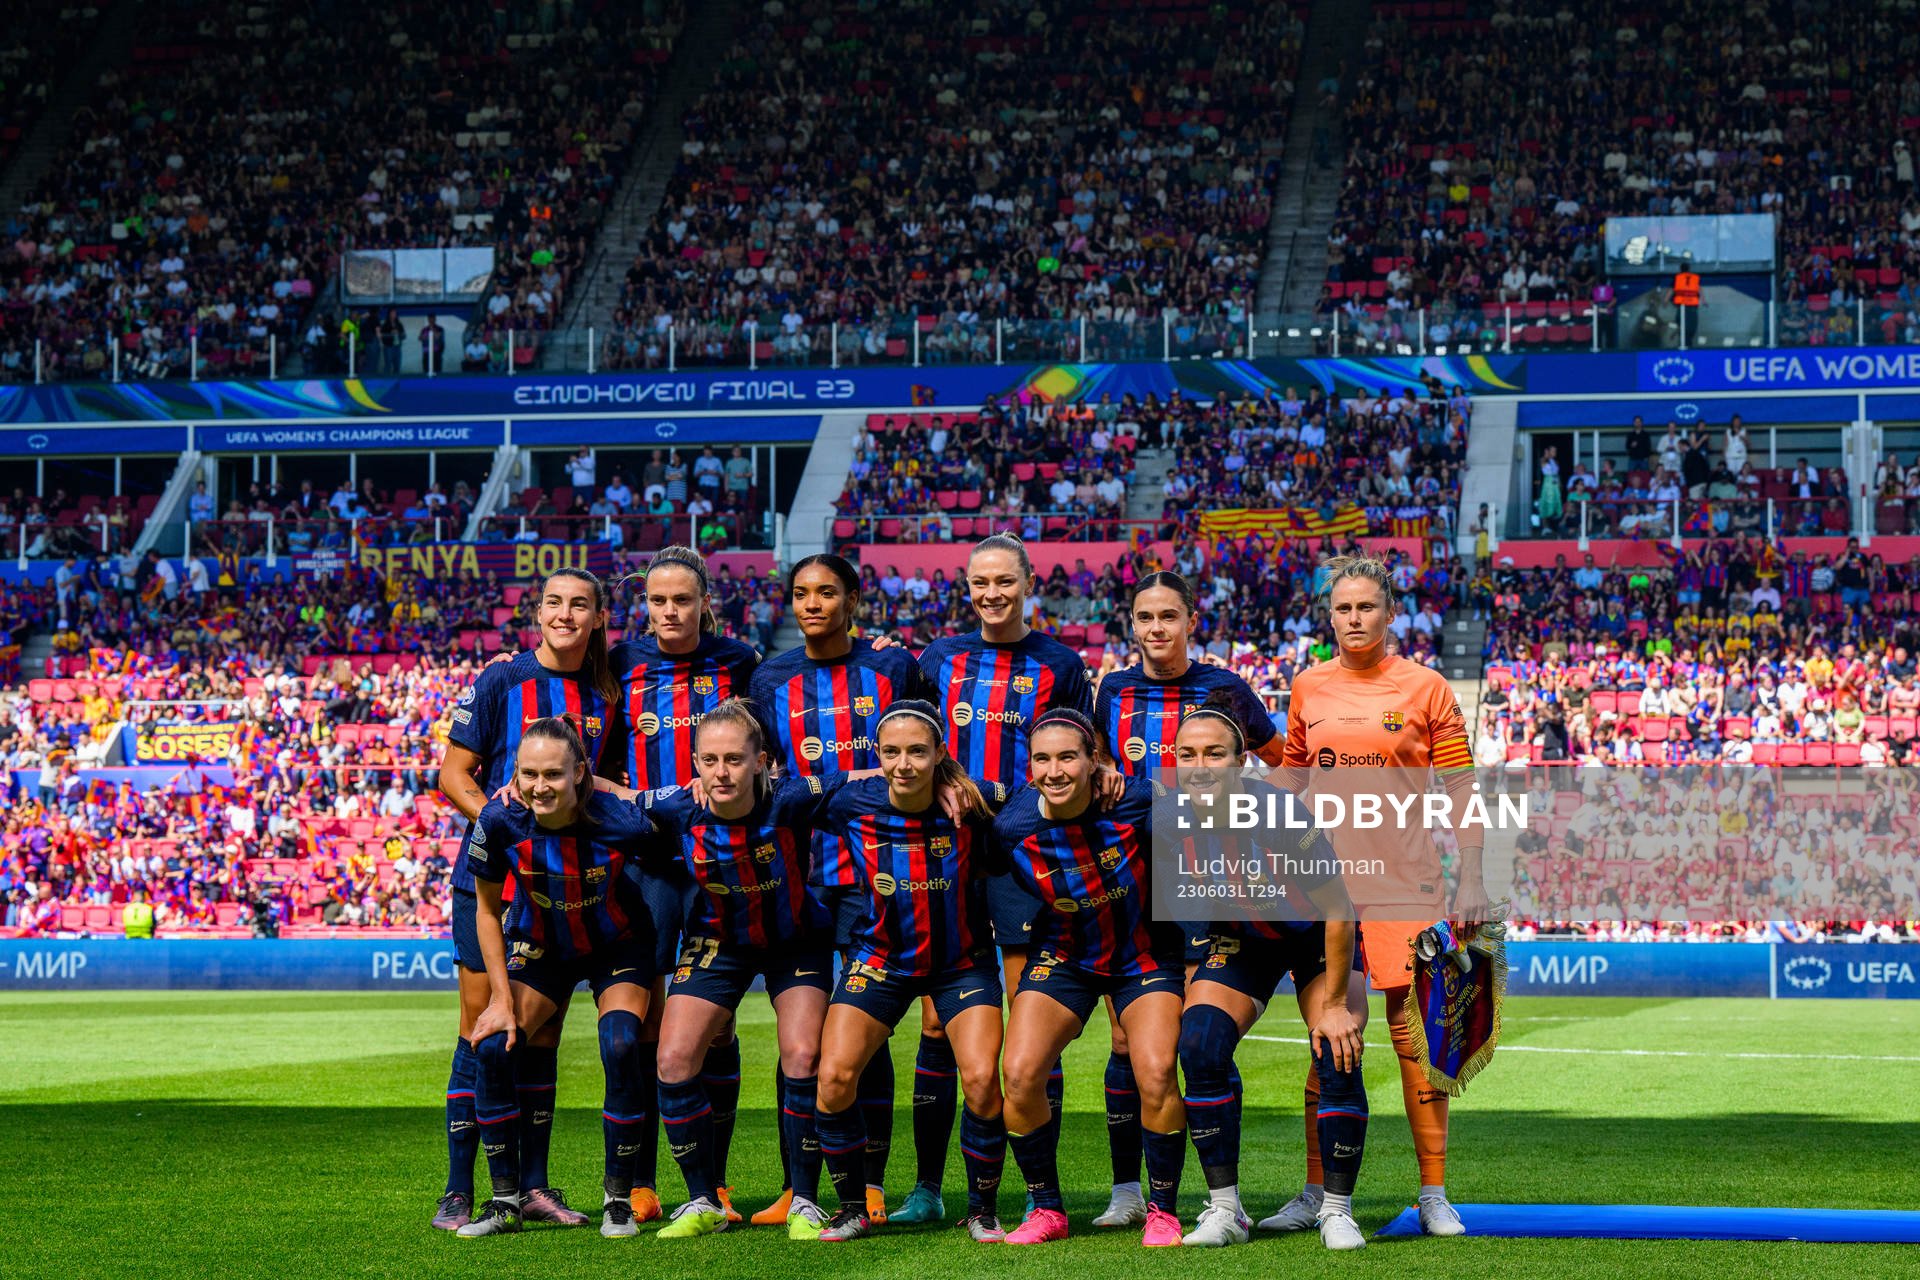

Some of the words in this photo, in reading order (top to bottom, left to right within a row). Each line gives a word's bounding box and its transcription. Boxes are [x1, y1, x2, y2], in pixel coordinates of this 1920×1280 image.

[1724, 357, 1805, 382] UEFA
[514, 383, 695, 404] EINDHOVEN
[708, 380, 806, 400] FINAL
[816, 380, 855, 398] 23
[226, 432, 259, 443] UEFA
[262, 430, 325, 443] WOMEN'S
[329, 429, 414, 441] CHAMPIONS
[418, 428, 470, 440] LEAGUE
[662, 712, 707, 730] Spotif
[976, 707, 1027, 727] Spotify
[826, 736, 874, 754] Spotify
[1339, 752, 1388, 768] Spotify
[731, 877, 782, 893] Spotify
[899, 878, 952, 893] Spotify
[555, 894, 604, 911] Spotify
[1080, 885, 1129, 910] Spotify
[678, 936, 721, 968] 27
[15, 951, 87, 979] МИР
[1528, 955, 1609, 984] МИР
[1847, 962, 1916, 983] UEFA
